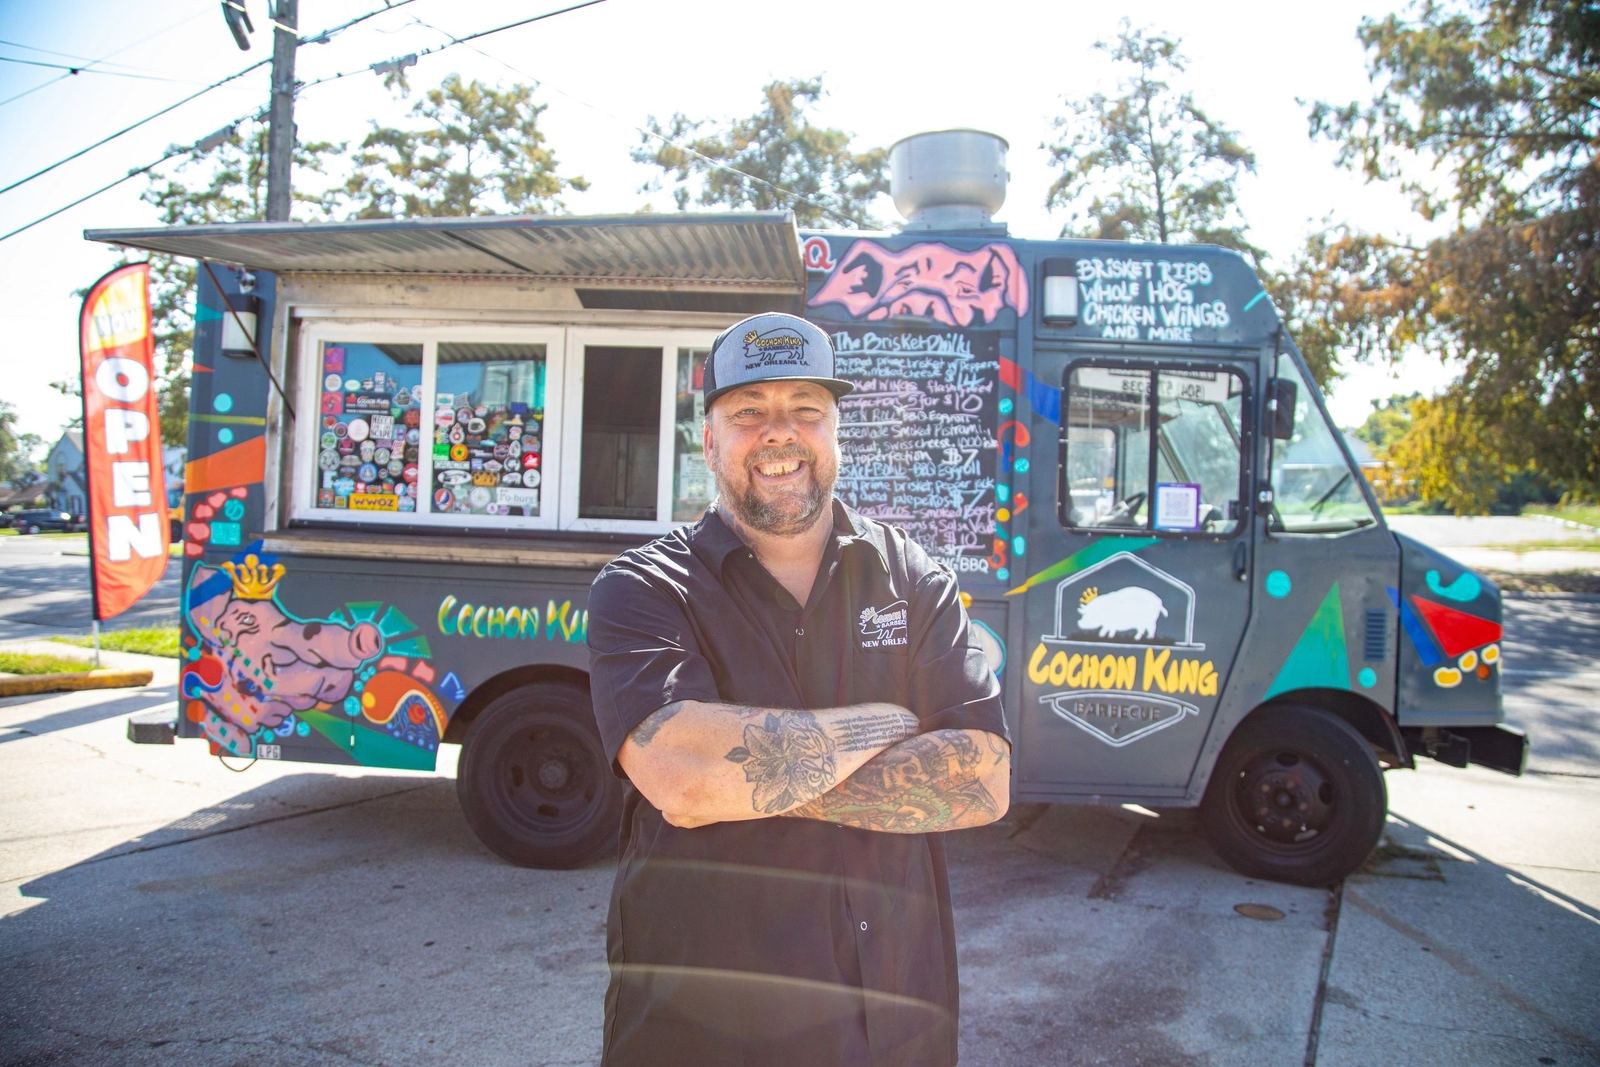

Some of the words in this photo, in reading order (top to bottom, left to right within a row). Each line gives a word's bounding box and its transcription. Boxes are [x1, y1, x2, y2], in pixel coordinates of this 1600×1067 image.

[805, 238, 833, 269] Q
[1076, 258, 1154, 281] BRISKET
[1158, 260, 1212, 285] RIBS
[1080, 280, 1140, 303] WHOLE
[1149, 280, 1193, 304] HOG
[1083, 302, 1155, 326] CHICKEN
[1160, 300, 1230, 328] WINGS
[1102, 325, 1138, 340] AND
[1148, 326, 1193, 342] MORE
[95, 356, 164, 562] OPEN
[353, 498, 394, 507] WWOZ
[960, 557, 990, 574] BBQ
[437, 594, 540, 641] COCHON
[862, 640, 879, 648] NEW
[881, 637, 907, 646] ORLEA
[1028, 642, 1137, 690] COCHON
[1143, 647, 1219, 697] KING
[1074, 702, 1161, 721] BARBECUE
